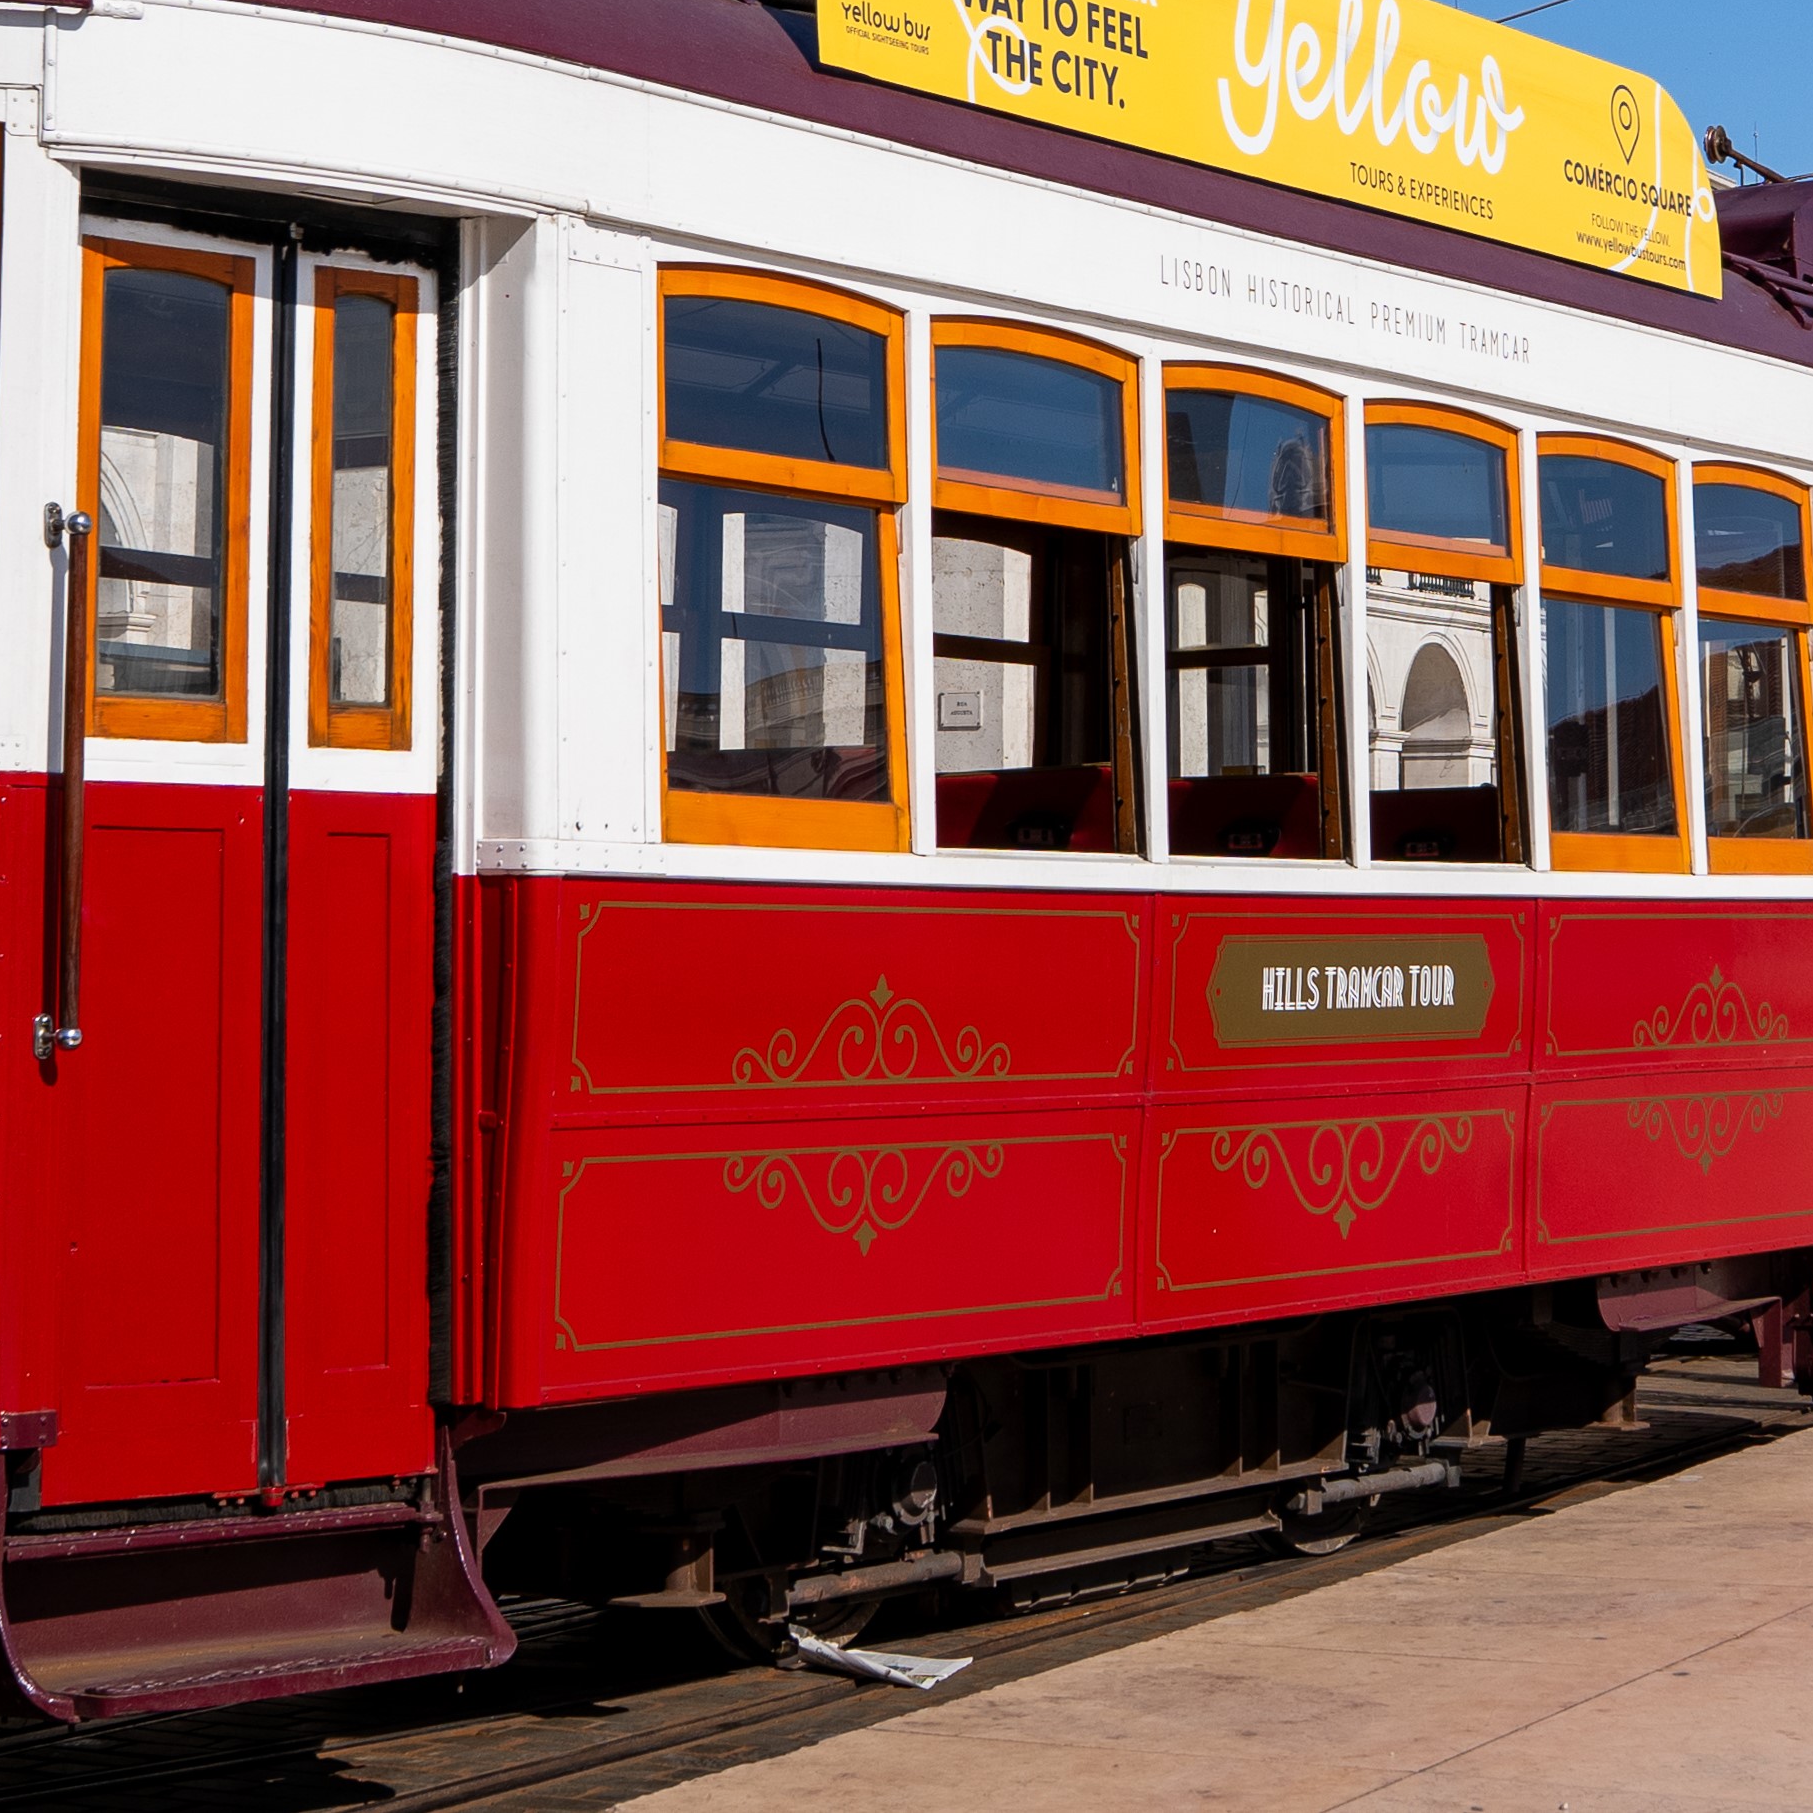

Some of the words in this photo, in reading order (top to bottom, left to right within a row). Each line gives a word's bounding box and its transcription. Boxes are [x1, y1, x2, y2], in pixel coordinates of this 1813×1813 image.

[846, 26, 871, 40] OFFICIAL
[872, 32, 909, 50] SIGHTSEEING
[910, 43, 929, 55] TOURS
[904, 12, 930, 41] bus
[1087, 1, 1149, 59] FEEL
[986, 29, 1044, 87] THE
[1051, 50, 1125, 110] CITY.
[1350, 161, 1396, 194] TOURS
[1397, 172, 1407, 198] &
[1410, 177, 1494, 221] EXPERIENCES
[1564, 159, 1637, 201] COMÉRCIO
[1641, 182, 1692, 217] SQUARE
[1591, 213, 1624, 233] FOLLOW
[1625, 222, 1639, 238] THE
[1576, 231, 1687, 272] www.yellowbustours.com
[1160, 254, 1231, 299] LISBON
[1248, 273, 1355, 325] HISTORICAL
[1371, 302, 1447, 345] PREMIUM
[1459, 322, 1531, 364] TRAMCAR
[1262, 967, 1319, 1010] HILLS
[1325, 966, 1404, 1009] TRAMCAR
[1409, 965, 1454, 1007] TOUR
